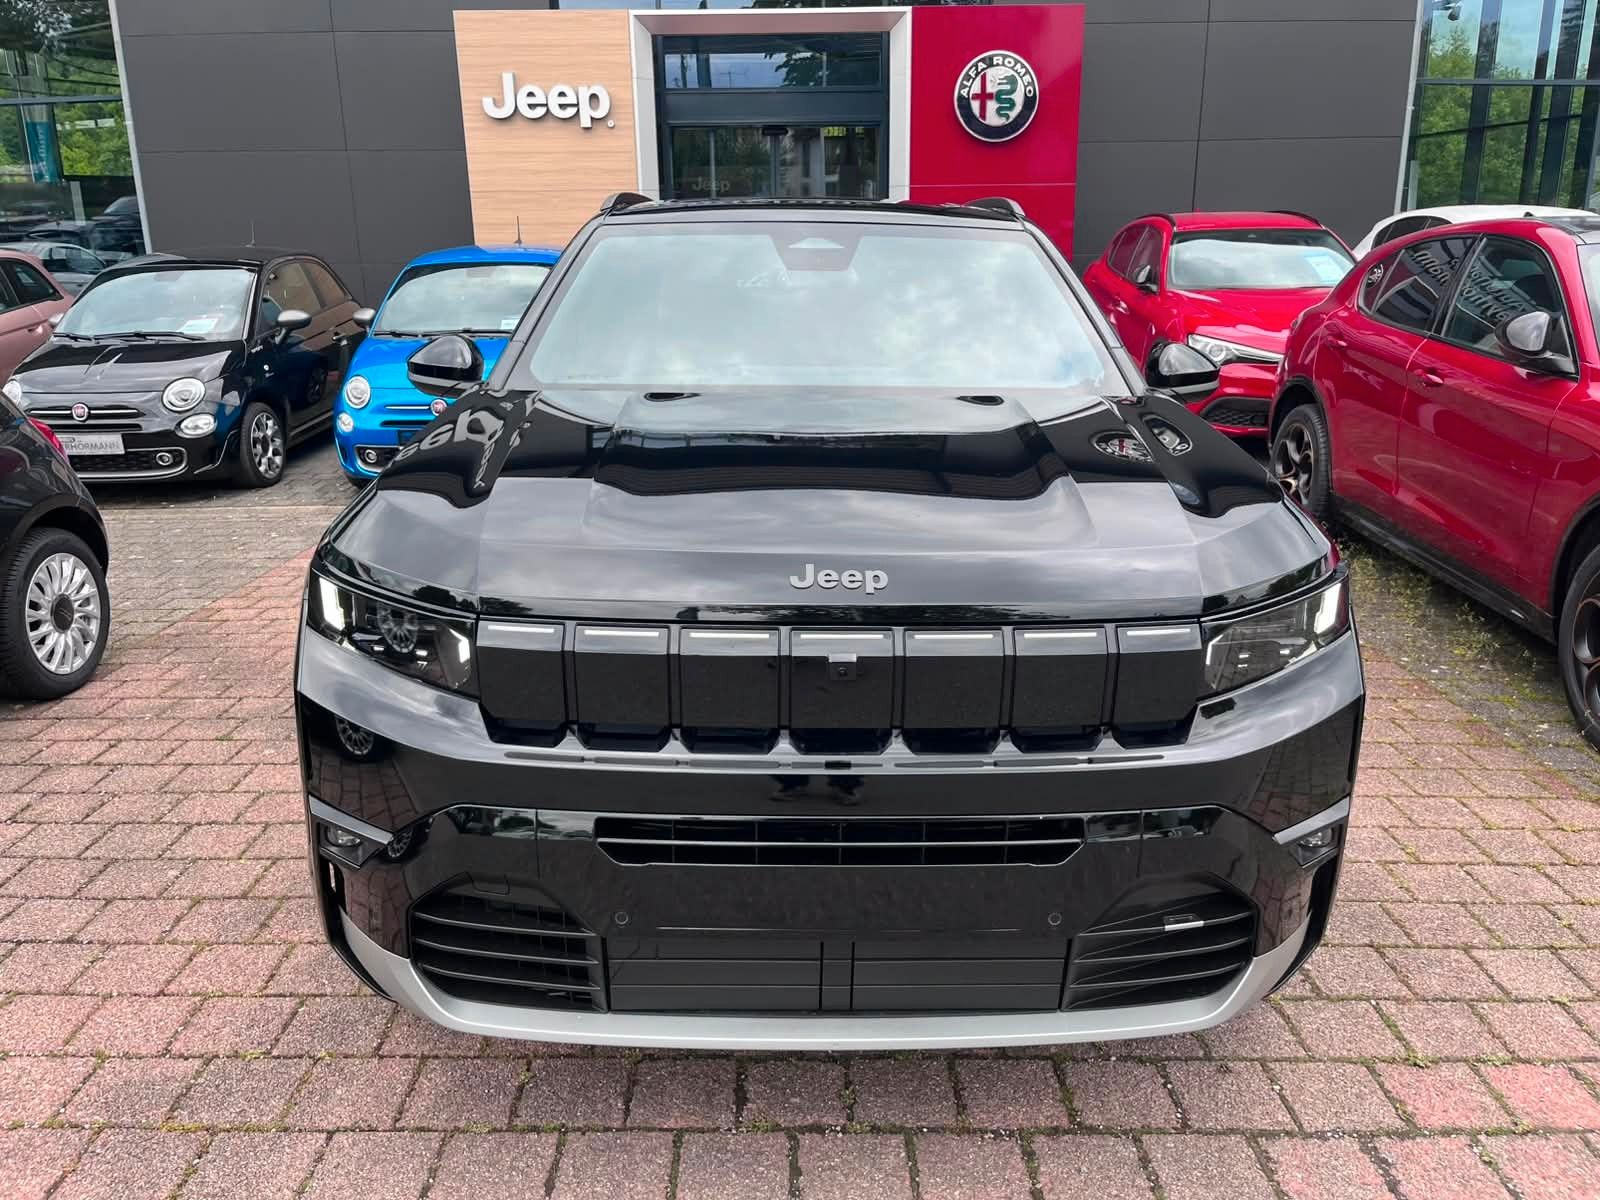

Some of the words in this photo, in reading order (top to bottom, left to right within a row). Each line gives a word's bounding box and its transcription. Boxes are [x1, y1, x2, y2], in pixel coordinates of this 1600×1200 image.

[960, 61, 987, 98] ALFA
[992, 56, 1034, 97] ROMEO
[481, 72, 612, 128] Jeep
[691, 176, 730, 193] Jeep
[789, 563, 889, 595] Jeep
